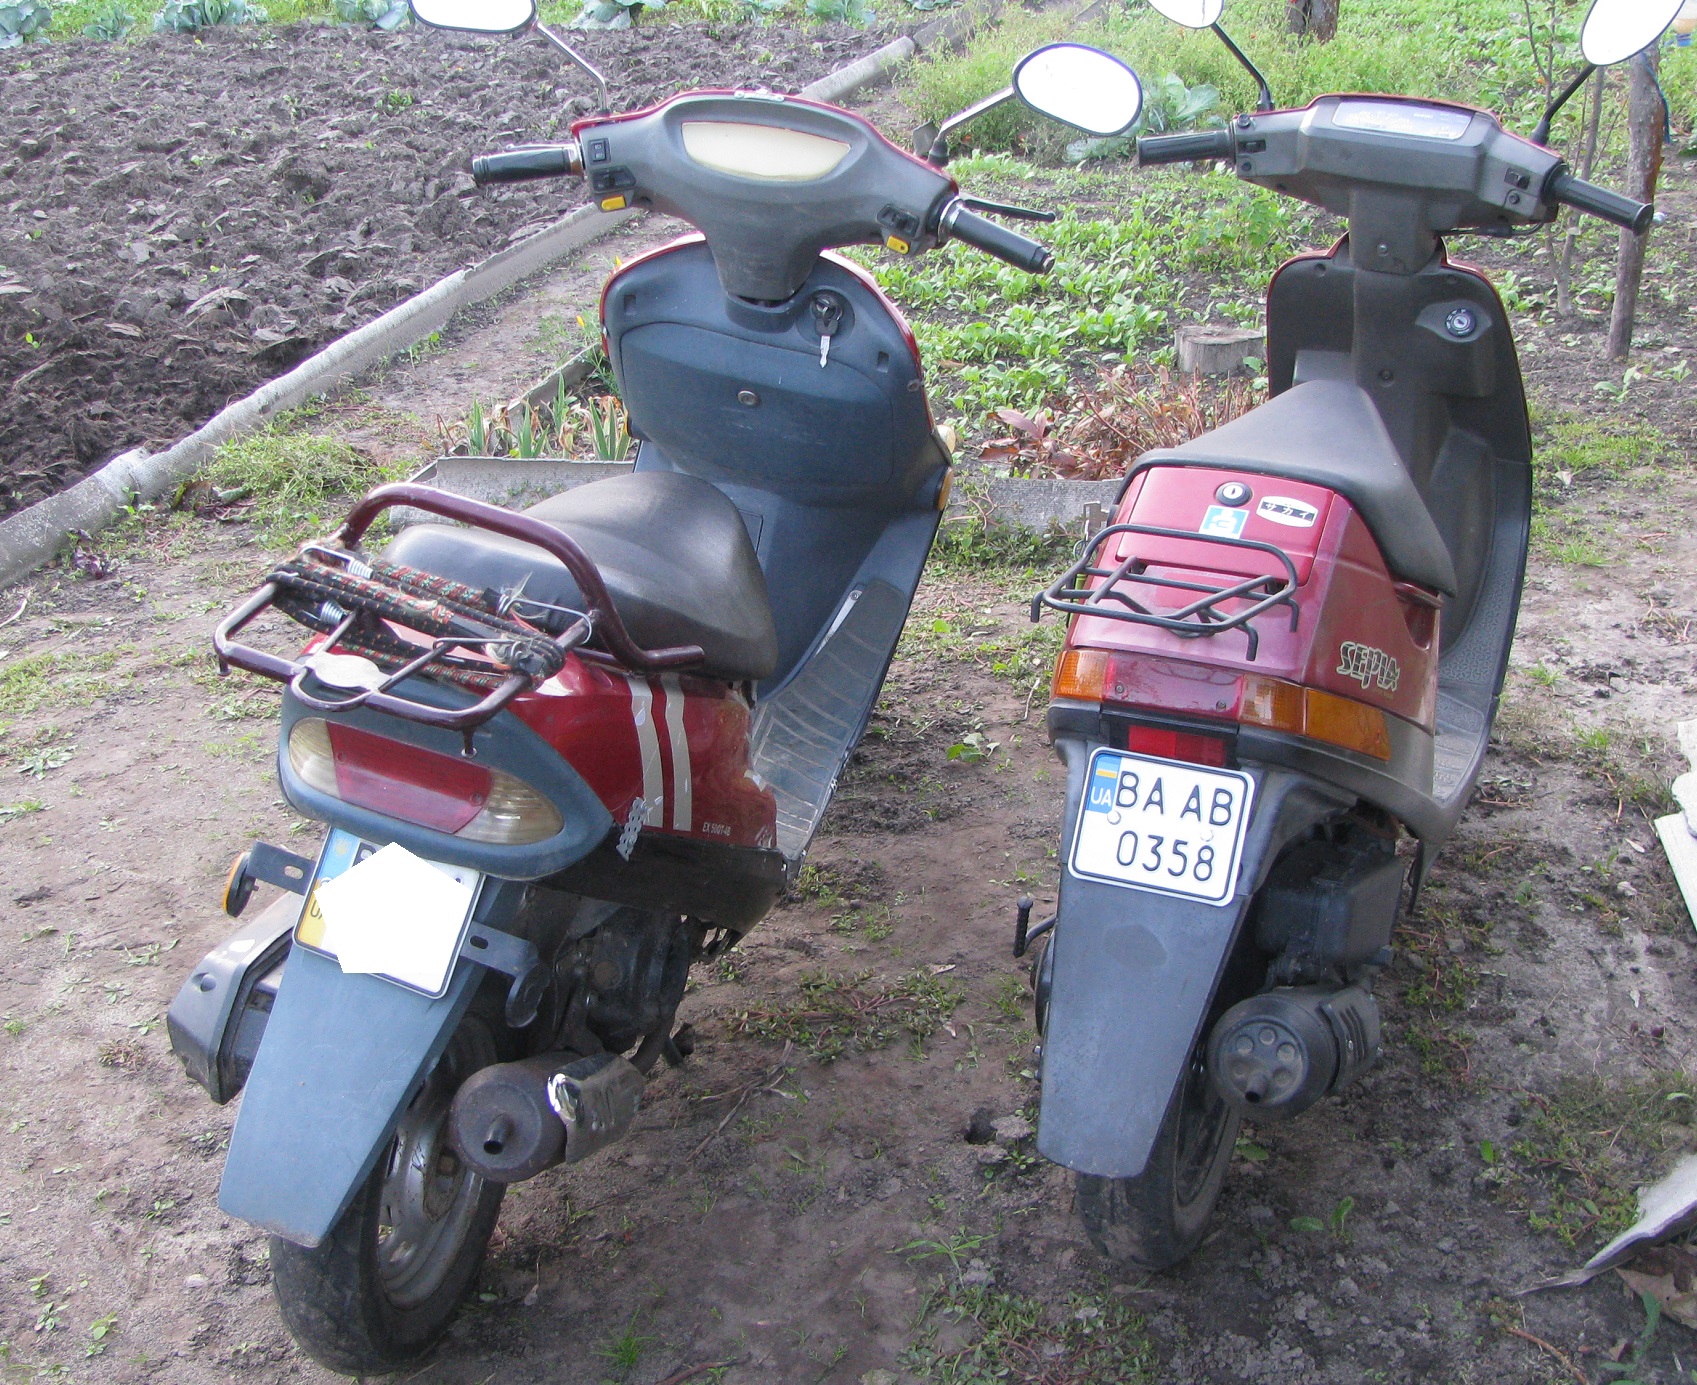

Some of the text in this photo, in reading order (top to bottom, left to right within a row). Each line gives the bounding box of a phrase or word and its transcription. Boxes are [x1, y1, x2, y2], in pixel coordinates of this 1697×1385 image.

[1336, 640, 1401, 692] SEPIA
[1090, 786, 1112, 807] UA
[1115, 770, 1233, 826] BA AB
[1116, 830, 1215, 882] 0358
